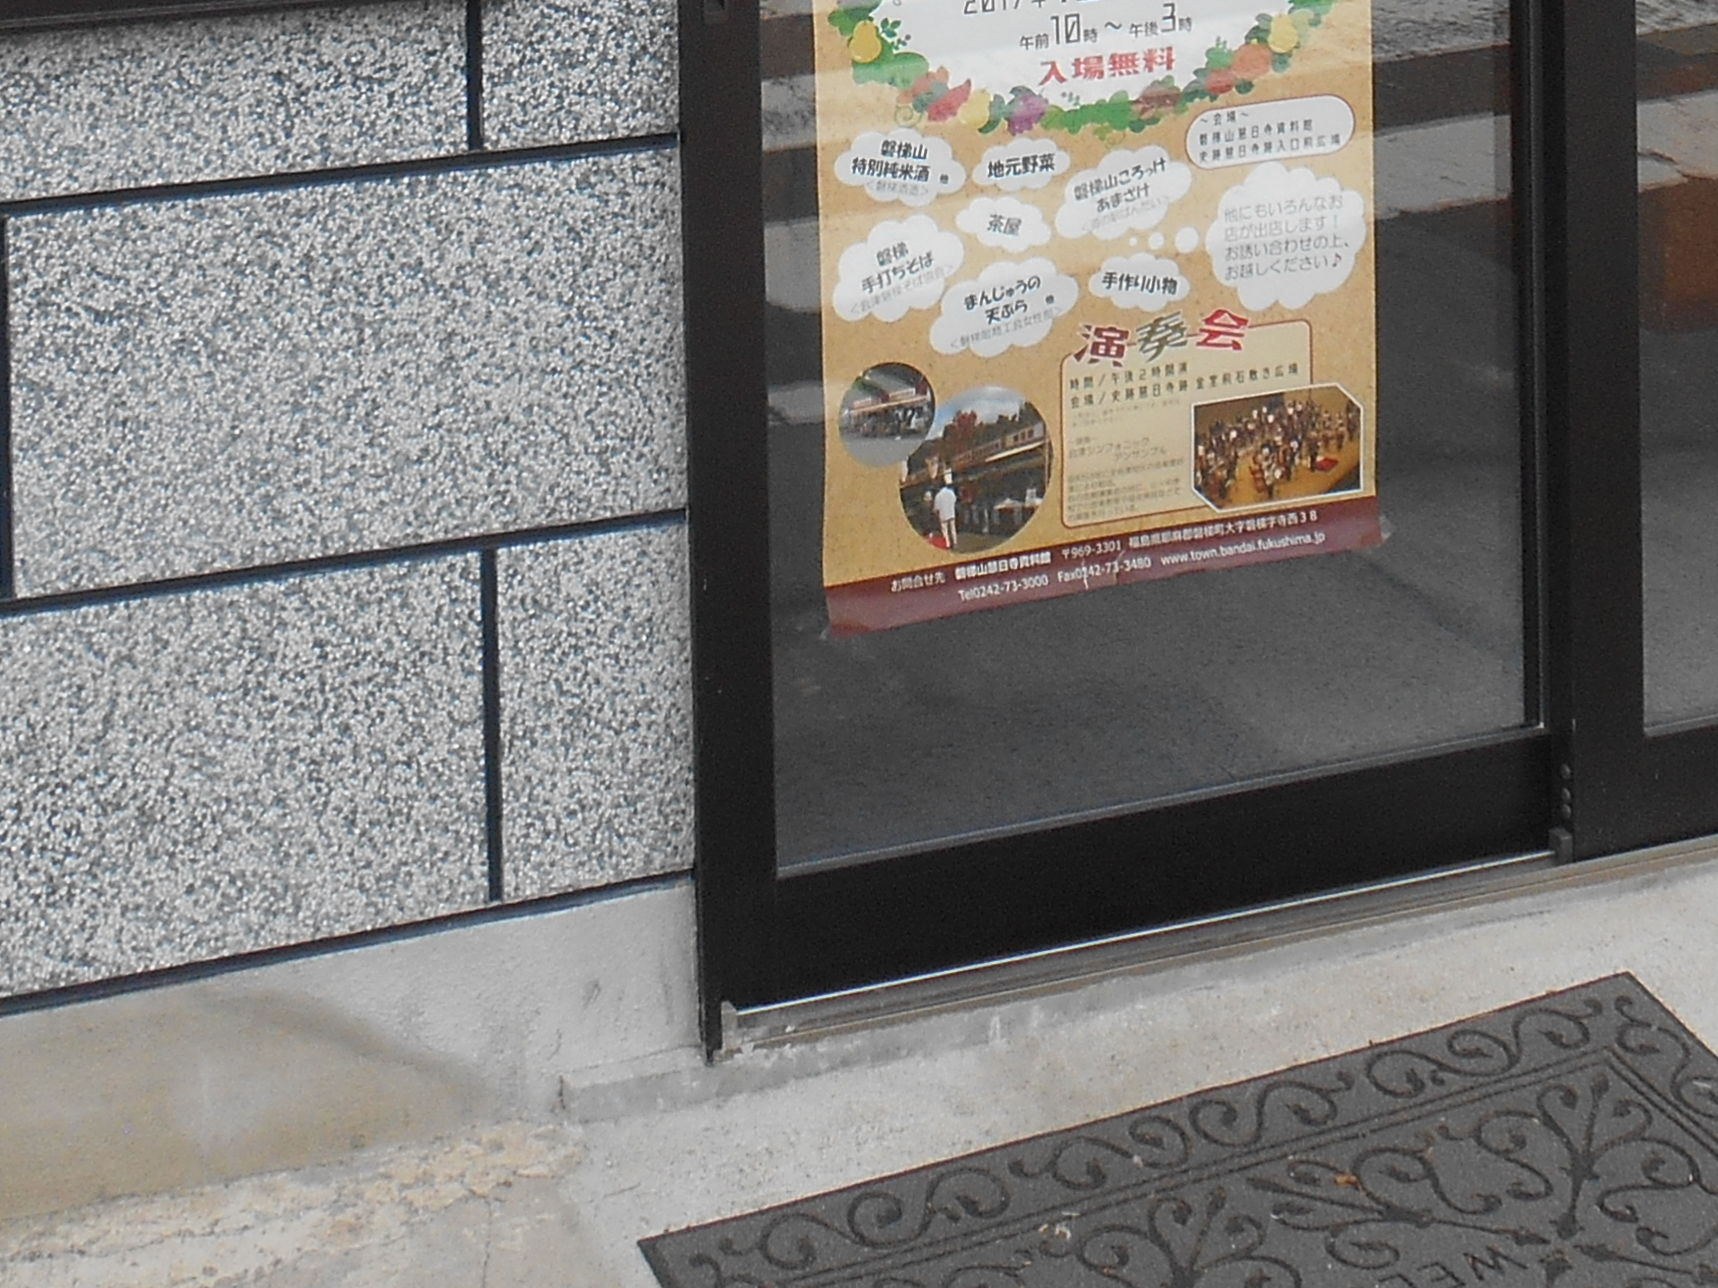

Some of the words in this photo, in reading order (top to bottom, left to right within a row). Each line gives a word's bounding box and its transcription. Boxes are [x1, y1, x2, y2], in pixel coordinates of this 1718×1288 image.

[1038, 45, 1176, 86] 入場無料
[881, 139, 928, 160] 磐梯山
[851, 157, 931, 183] 特別純米酒
[987, 152, 1056, 178] 地元野菜
[1095, 184, 1151, 213] あまざけ
[1224, 193, 1344, 223] 他にもいろんなお
[986, 213, 1023, 237] 茶屋
[861, 251, 935, 295] 手打ちそば
[1102, 272, 1178, 296] 手作り小物
[964, 275, 1042, 312] まんじゅうの
[985, 298, 1028, 325] 天ぷら
[1073, 309, 1249, 368] 演奏会
[1160, 530, 1326, 567] www.town.bandai.fukushima.jp
